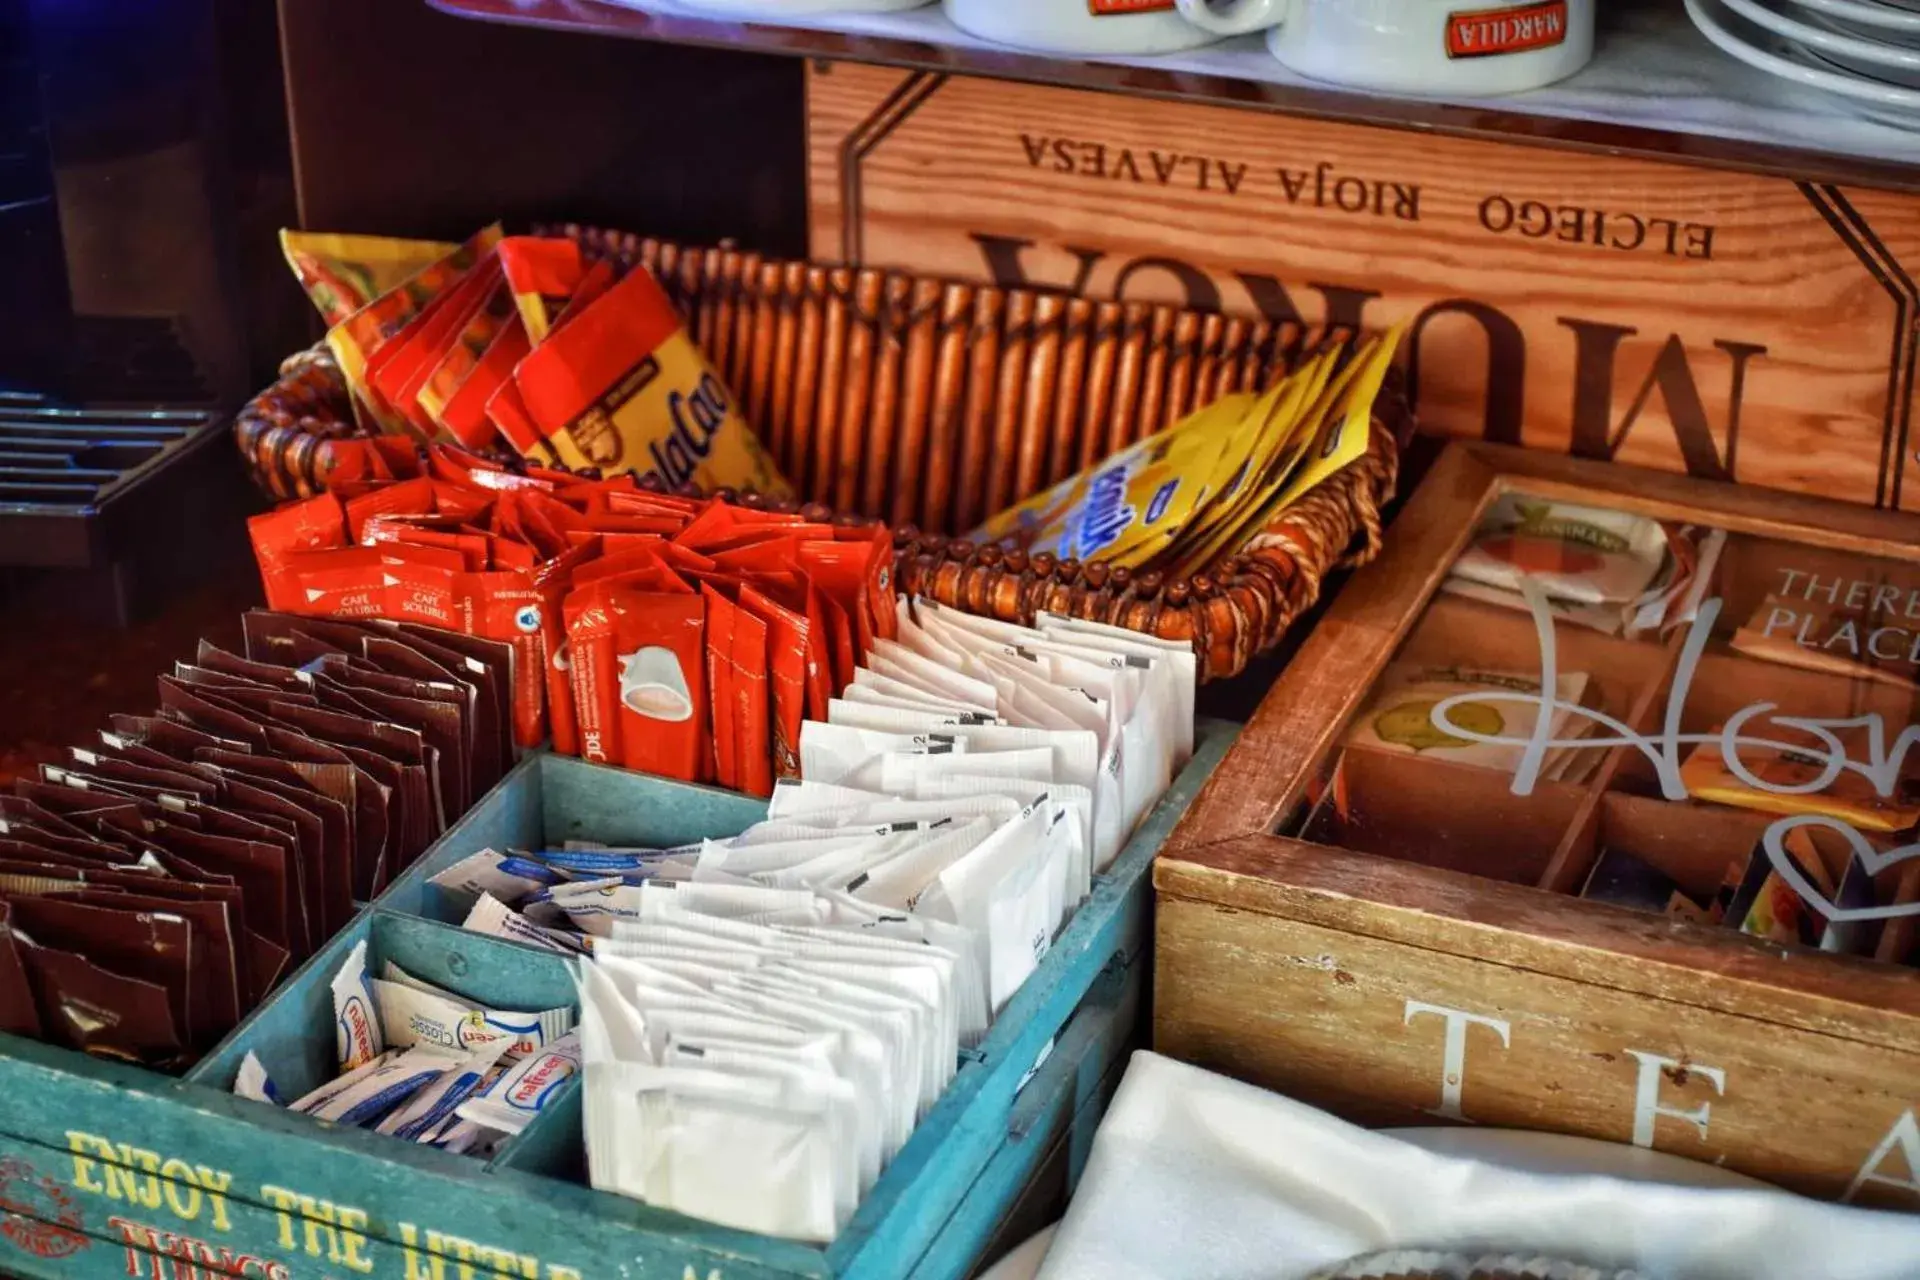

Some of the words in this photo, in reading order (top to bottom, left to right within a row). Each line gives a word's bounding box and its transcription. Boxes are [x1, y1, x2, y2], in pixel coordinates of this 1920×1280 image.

[1459, 8, 1561, 47] MARCILLA
[1020, 132, 1249, 195] ALAVESA
[1276, 161, 1421, 221] RIOJA
[1478, 194, 1716, 261] ELCIEGO
[585, 731, 607, 761] JDE
[65, 1130, 233, 1232] ENJOY
[260, 1184, 374, 1274] THE
[398, 1221, 582, 1280] LITT
